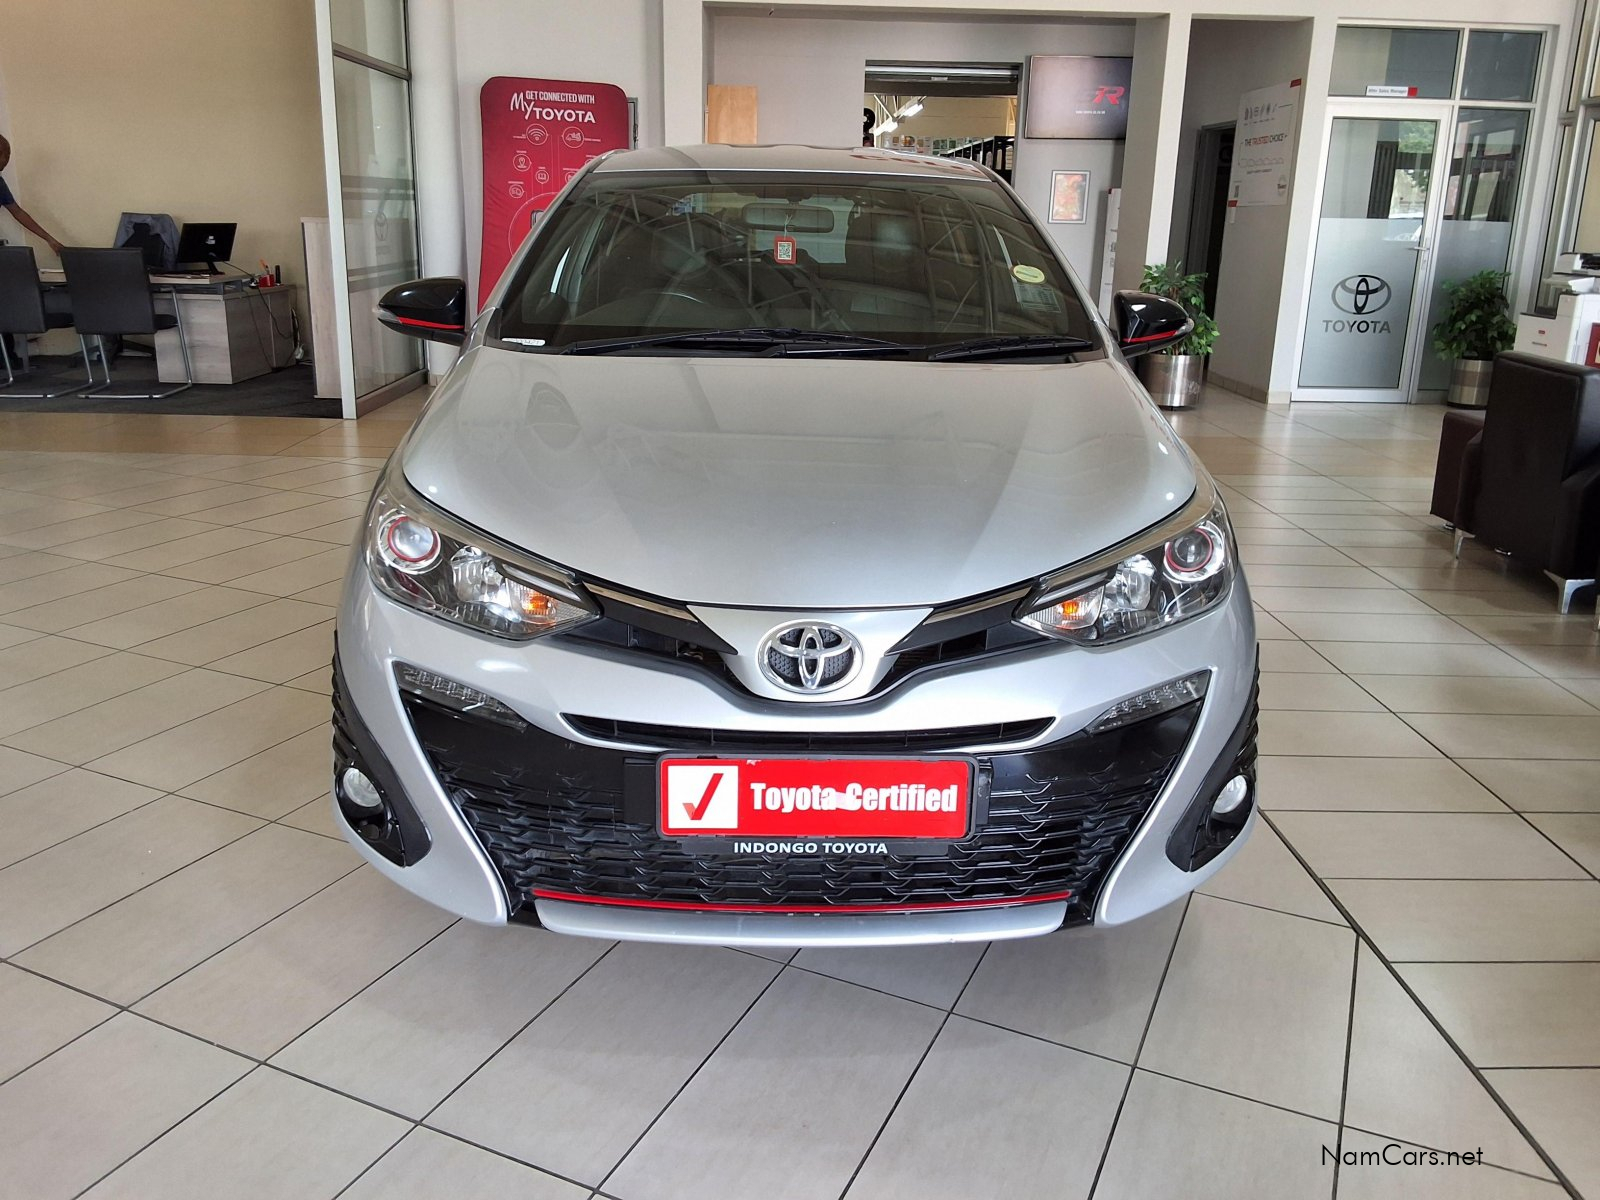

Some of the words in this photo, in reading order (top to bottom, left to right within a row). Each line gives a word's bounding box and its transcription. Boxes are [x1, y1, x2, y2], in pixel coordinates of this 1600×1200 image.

[526, 90, 538, 100] GET
[538, 91, 577, 103] CONNECTED
[578, 93, 595, 104] WITH
[1252, 135, 1269, 145] TRUSTED
[1322, 320, 1391, 334] TOYOTA
[750, 782, 836, 813] Toyota
[845, 783, 958, 812] Certified
[733, 842, 818, 854] INDONGO
[823, 842, 888, 854] TOYOTA
